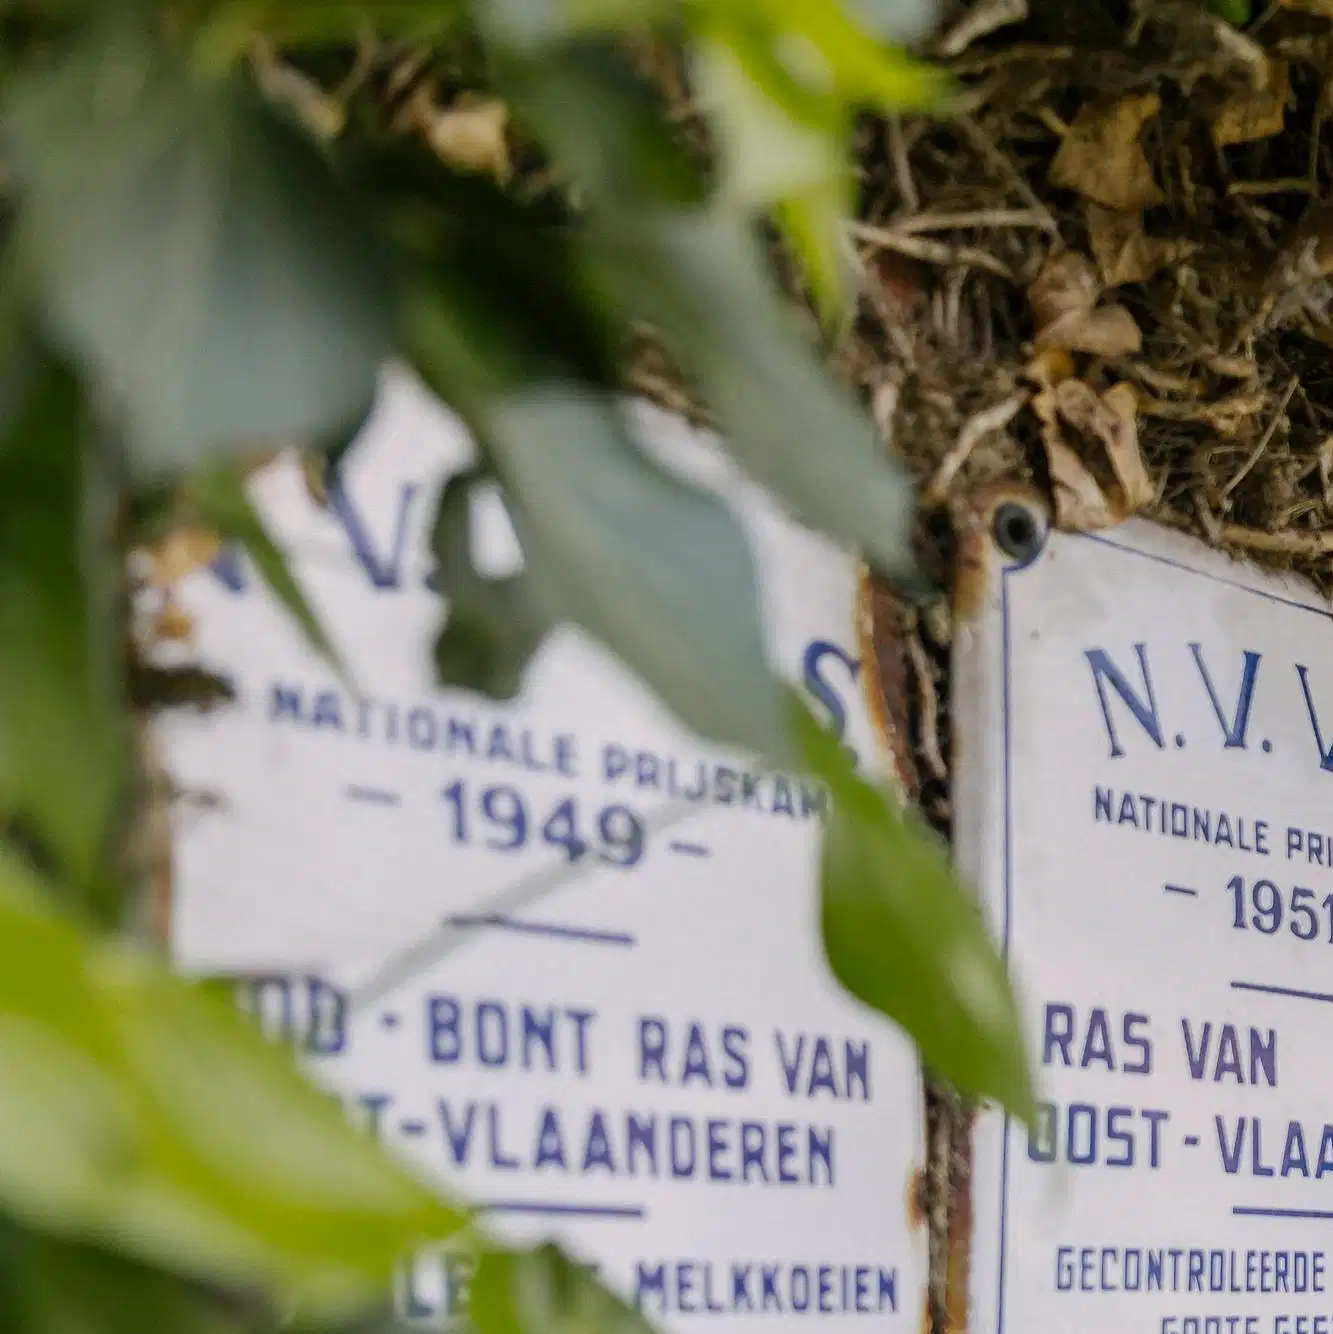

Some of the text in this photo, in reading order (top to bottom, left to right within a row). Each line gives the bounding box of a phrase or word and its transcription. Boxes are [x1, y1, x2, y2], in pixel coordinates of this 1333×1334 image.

[272, 682, 830, 818] NATIONALE PRIJSKAM
[442, 778, 646, 868] 1949
[1095, 787, 1268, 855] NATIONALE
[428, 996, 593, 1072] BONT
[640, 1018, 748, 1089] RAS
[777, 1035, 869, 1100] VAN
[1042, 1004, 1276, 1086] RAS VAN
[358, 1093, 838, 1186] T-VLAANDEREN
[634, 1262, 898, 1315] MELKKOEIEN
[1057, 1248, 1324, 1292] GECONTROLEERDE
